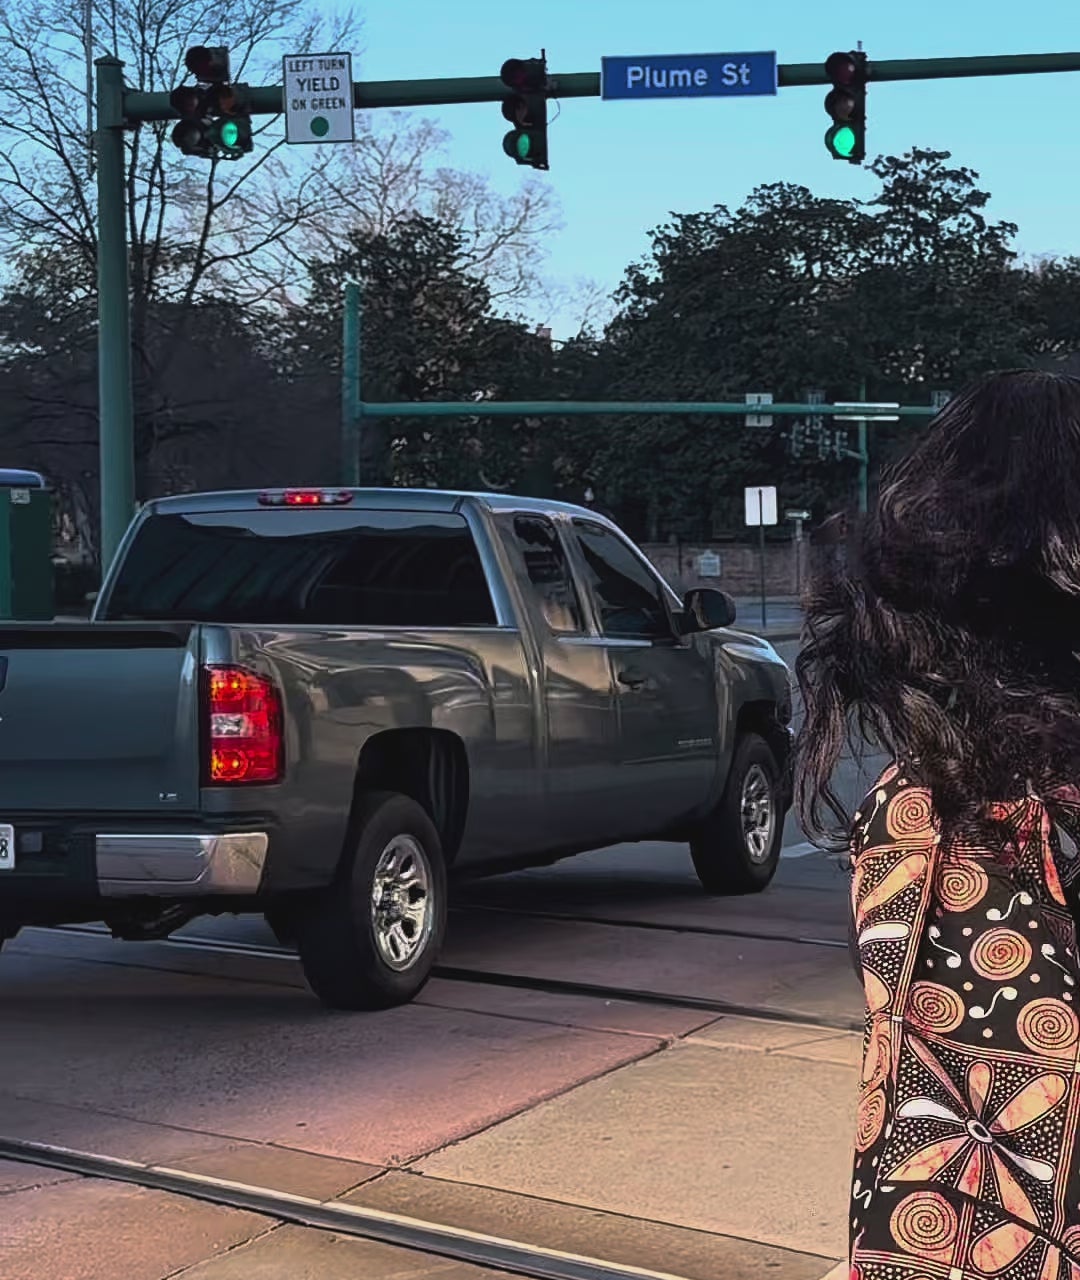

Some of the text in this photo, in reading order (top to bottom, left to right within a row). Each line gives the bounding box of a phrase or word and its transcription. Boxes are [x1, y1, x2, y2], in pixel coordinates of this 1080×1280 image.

[289, 59, 345, 72] LEFT TURN
[626, 62, 751, 89] Plume St
[297, 77, 340, 92] YIELD
[292, 97, 346, 111] ON GREEN
